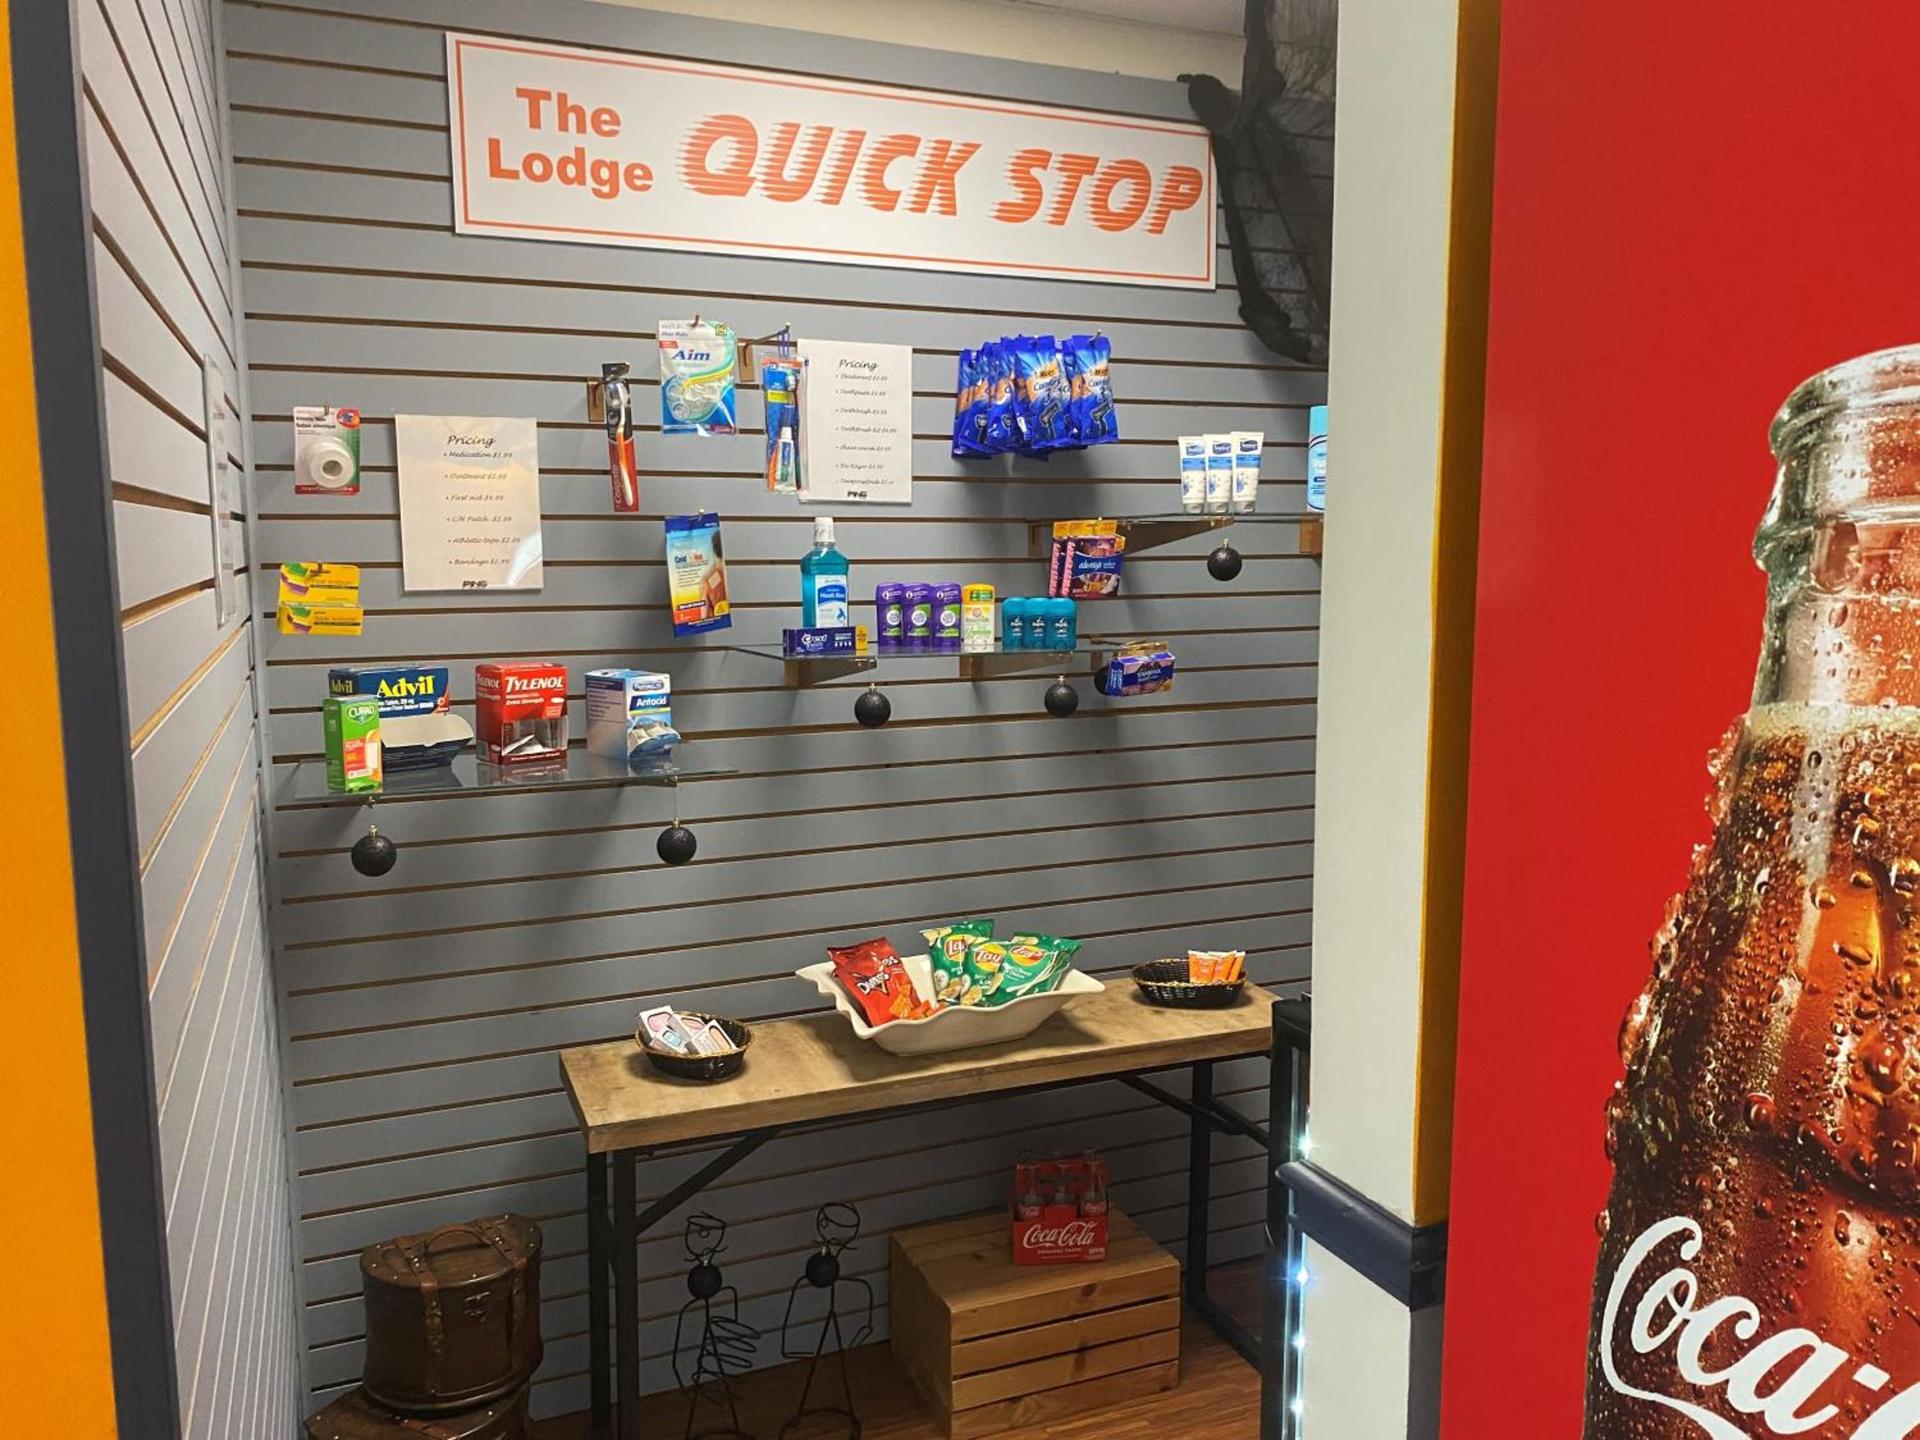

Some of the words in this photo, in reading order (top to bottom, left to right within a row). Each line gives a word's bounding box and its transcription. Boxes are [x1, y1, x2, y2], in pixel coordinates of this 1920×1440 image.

[515, 86, 621, 138] The
[487, 137, 654, 200] Lodge
[674, 113, 983, 216] QUICK
[990, 148, 1204, 235] STOP
[672, 348, 711, 361] Aim
[839, 359, 880, 372] Pricing
[447, 434, 496, 448] Pricing
[462, 580, 488, 588] PING
[377, 675, 435, 697] Advil
[504, 675, 565, 693] TYLENOL
[636, 695, 667, 708] Antacid
[856, 971, 890, 995] Doritos
[1600, 1216, 1920, 1440] Coca-
